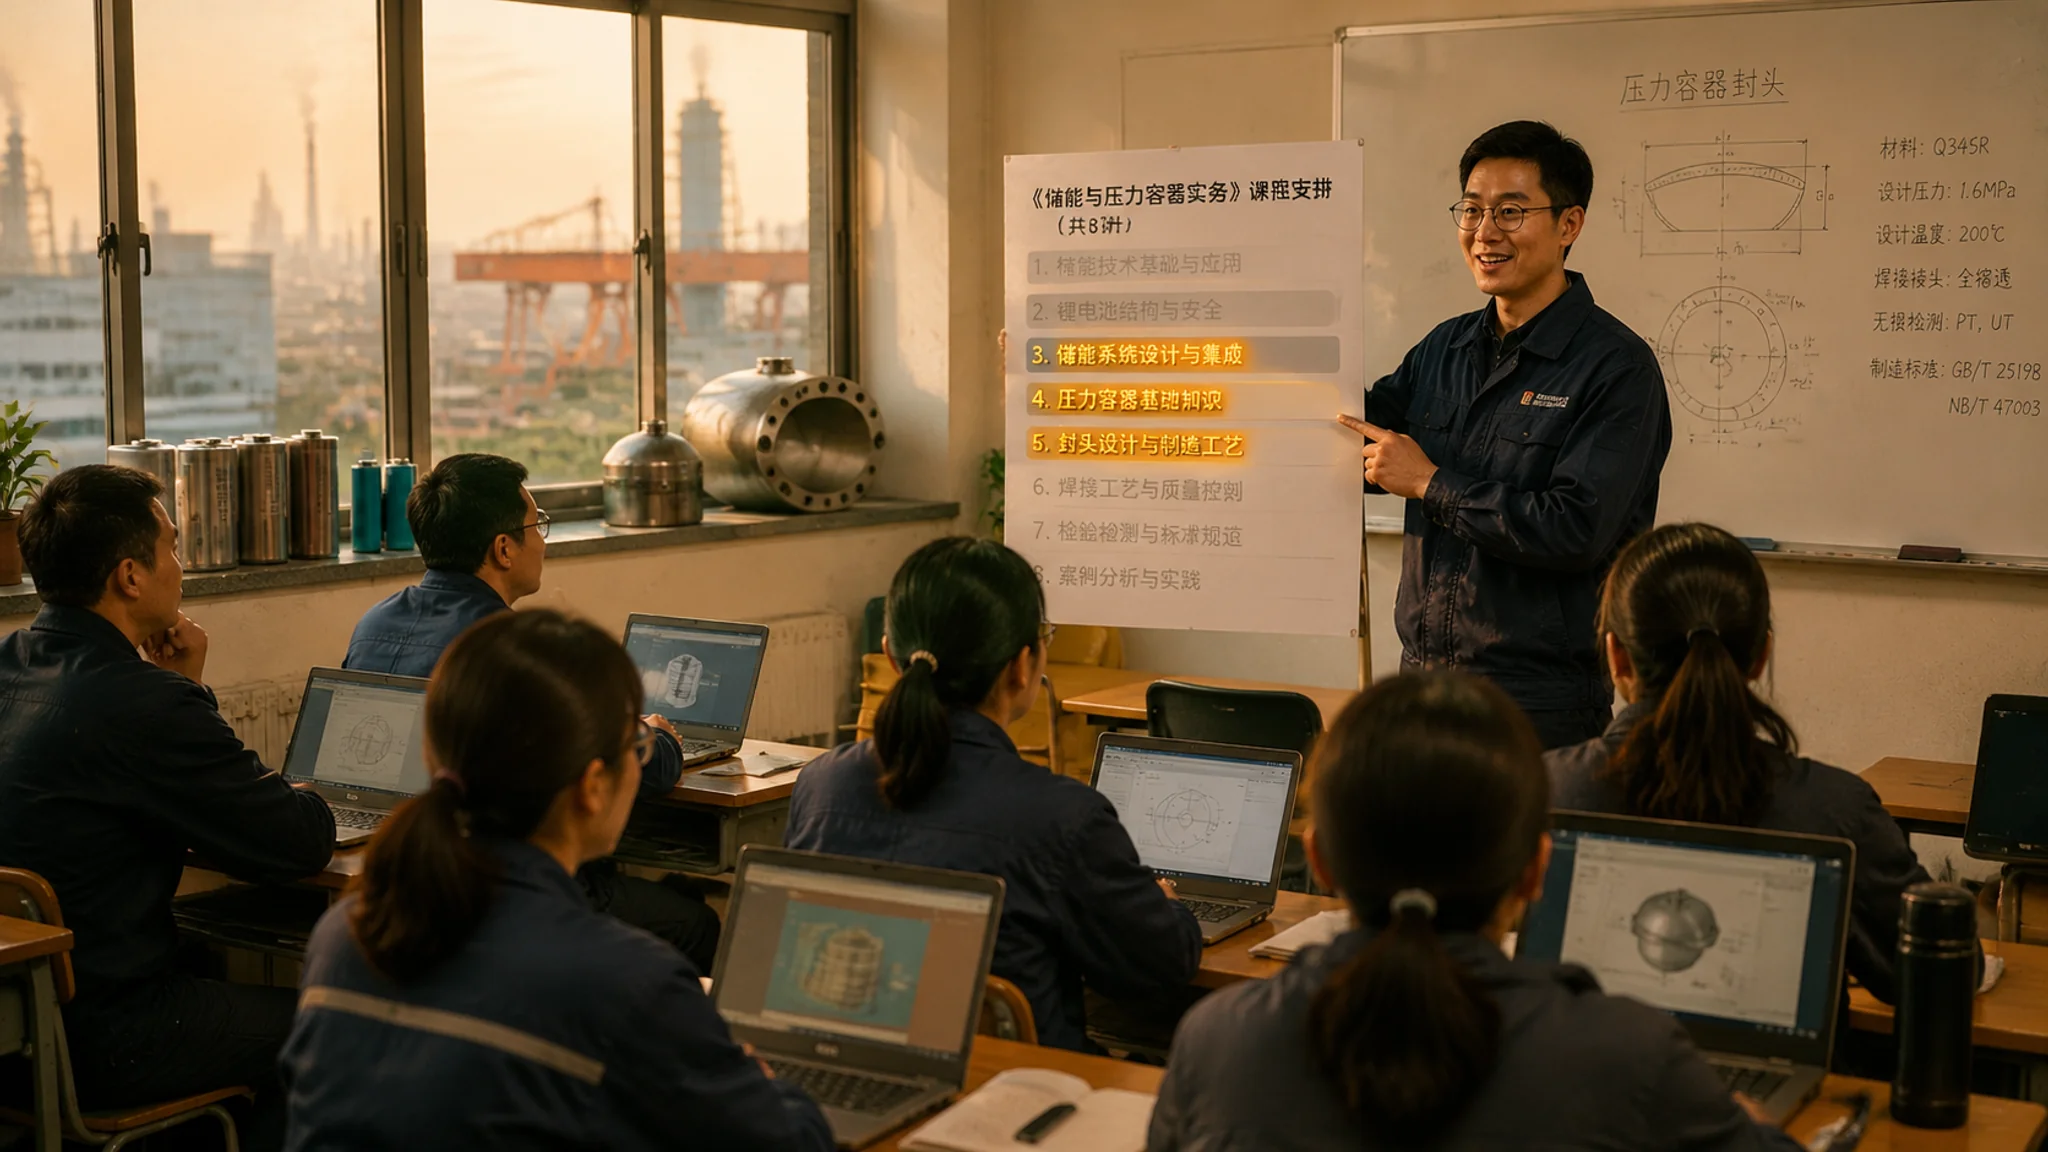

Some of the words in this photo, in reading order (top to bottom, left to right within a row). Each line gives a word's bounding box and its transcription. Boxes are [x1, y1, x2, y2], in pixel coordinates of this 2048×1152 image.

[1620, 67, 1785, 105] 压力容器封头
[1878, 181, 1952, 202] 设计压力：
[1960, 180, 2016, 199] 1.6MPa
[1034, 258, 1049, 276] 1.
[1032, 302, 1049, 321] 2.
[1991, 314, 2014, 331] UT
[1032, 345, 1049, 364] 3.
[1952, 359, 1992, 382] GB/T
[1996, 362, 2042, 381] 25198
[1031, 389, 1050, 409] 4.
[1948, 397, 1989, 416] NB/T
[1993, 398, 2041, 417] 47003
[1032, 433, 1050, 452] 5.
[1033, 477, 1050, 496] 6.
[1033, 521, 1050, 540] 7.
